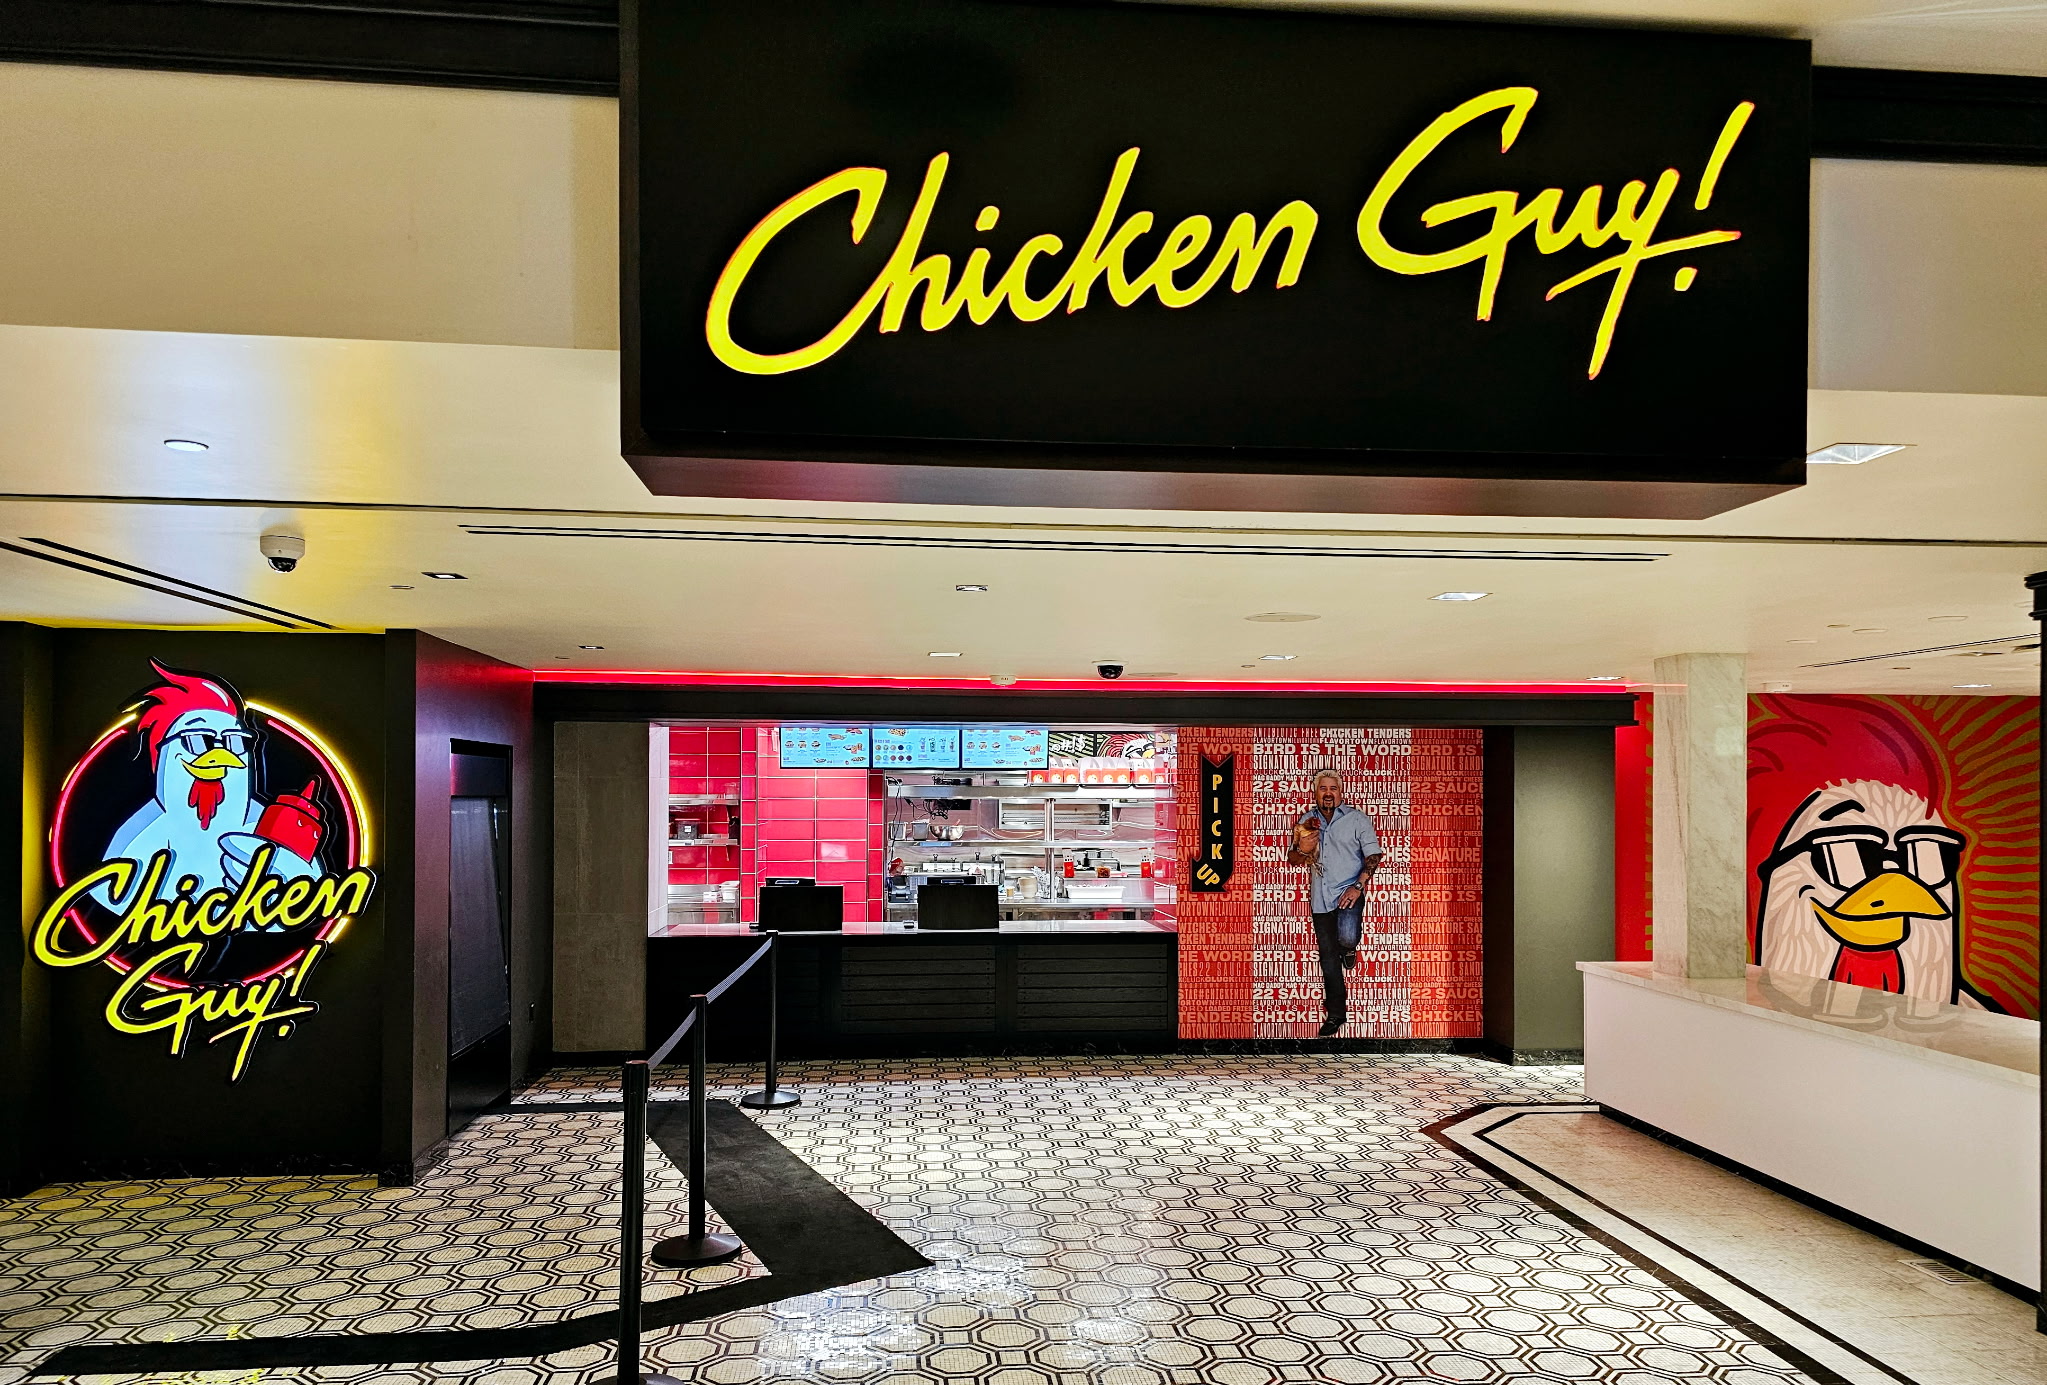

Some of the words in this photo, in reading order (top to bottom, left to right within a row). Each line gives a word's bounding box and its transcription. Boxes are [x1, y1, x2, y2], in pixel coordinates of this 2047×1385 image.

[705, 146, 1318, 375] Chicken
[1357, 86, 1755, 379] Guy!
[1209, 728, 1253, 737] TENDERS
[1320, 728, 1365, 738] CHICKEN
[1367, 728, 1412, 738] TENDERS
[1203, 743, 1253, 754] WORD
[1253, 744, 1296, 755] BIRD
[1301, 744, 1321, 755] IS
[1325, 744, 1357, 755] THE
[1361, 744, 1412, 755] WORD
[1411, 745, 1453, 755] BIRD
[1457, 745, 1477, 755] IS
[1253, 755, 1299, 770] SIGNATURE
[1303, 755, 1356, 770] SANDWICHES
[1375, 755, 1411, 770] SAUCES
[1253, 781, 1274, 792] 22
[1411, 782, 1431, 793] 22
[1211, 774, 1223, 859] PICK
[1411, 848, 1480, 862] SIGNATURE
[1197, 864, 1220, 885] UP
[1253, 890, 1296, 901] BIRD
[1411, 891, 1453, 901] BIRD
[1457, 891, 1477, 901] IS
[33, 846, 370, 967] Chicken
[1253, 922, 1307, 933] SIGNATURE
[1411, 922, 1464, 933] SIGNATURE
[1209, 934, 1253, 944] TENDERS
[1367, 934, 1412, 944] TENDERS
[1203, 951, 1253, 961] WORD
[1253, 951, 1296, 961] BIRD
[1301, 951, 1321, 961] IS
[1361, 951, 1412, 962] WORD
[1411, 951, 1453, 961] BIRD
[1457, 951, 1477, 961] IS
[1253, 962, 1299, 976] SIGNATURE
[1253, 989, 1274, 999] 22
[1347, 988, 1412, 999] AG#CHICKENGUY
[1411, 988, 1431, 999] 22
[105, 942, 323, 1081] Guy!
[1178, 1012, 1253, 1022] TENDERS
[1346, 1012, 1411, 1022] ENDERS
